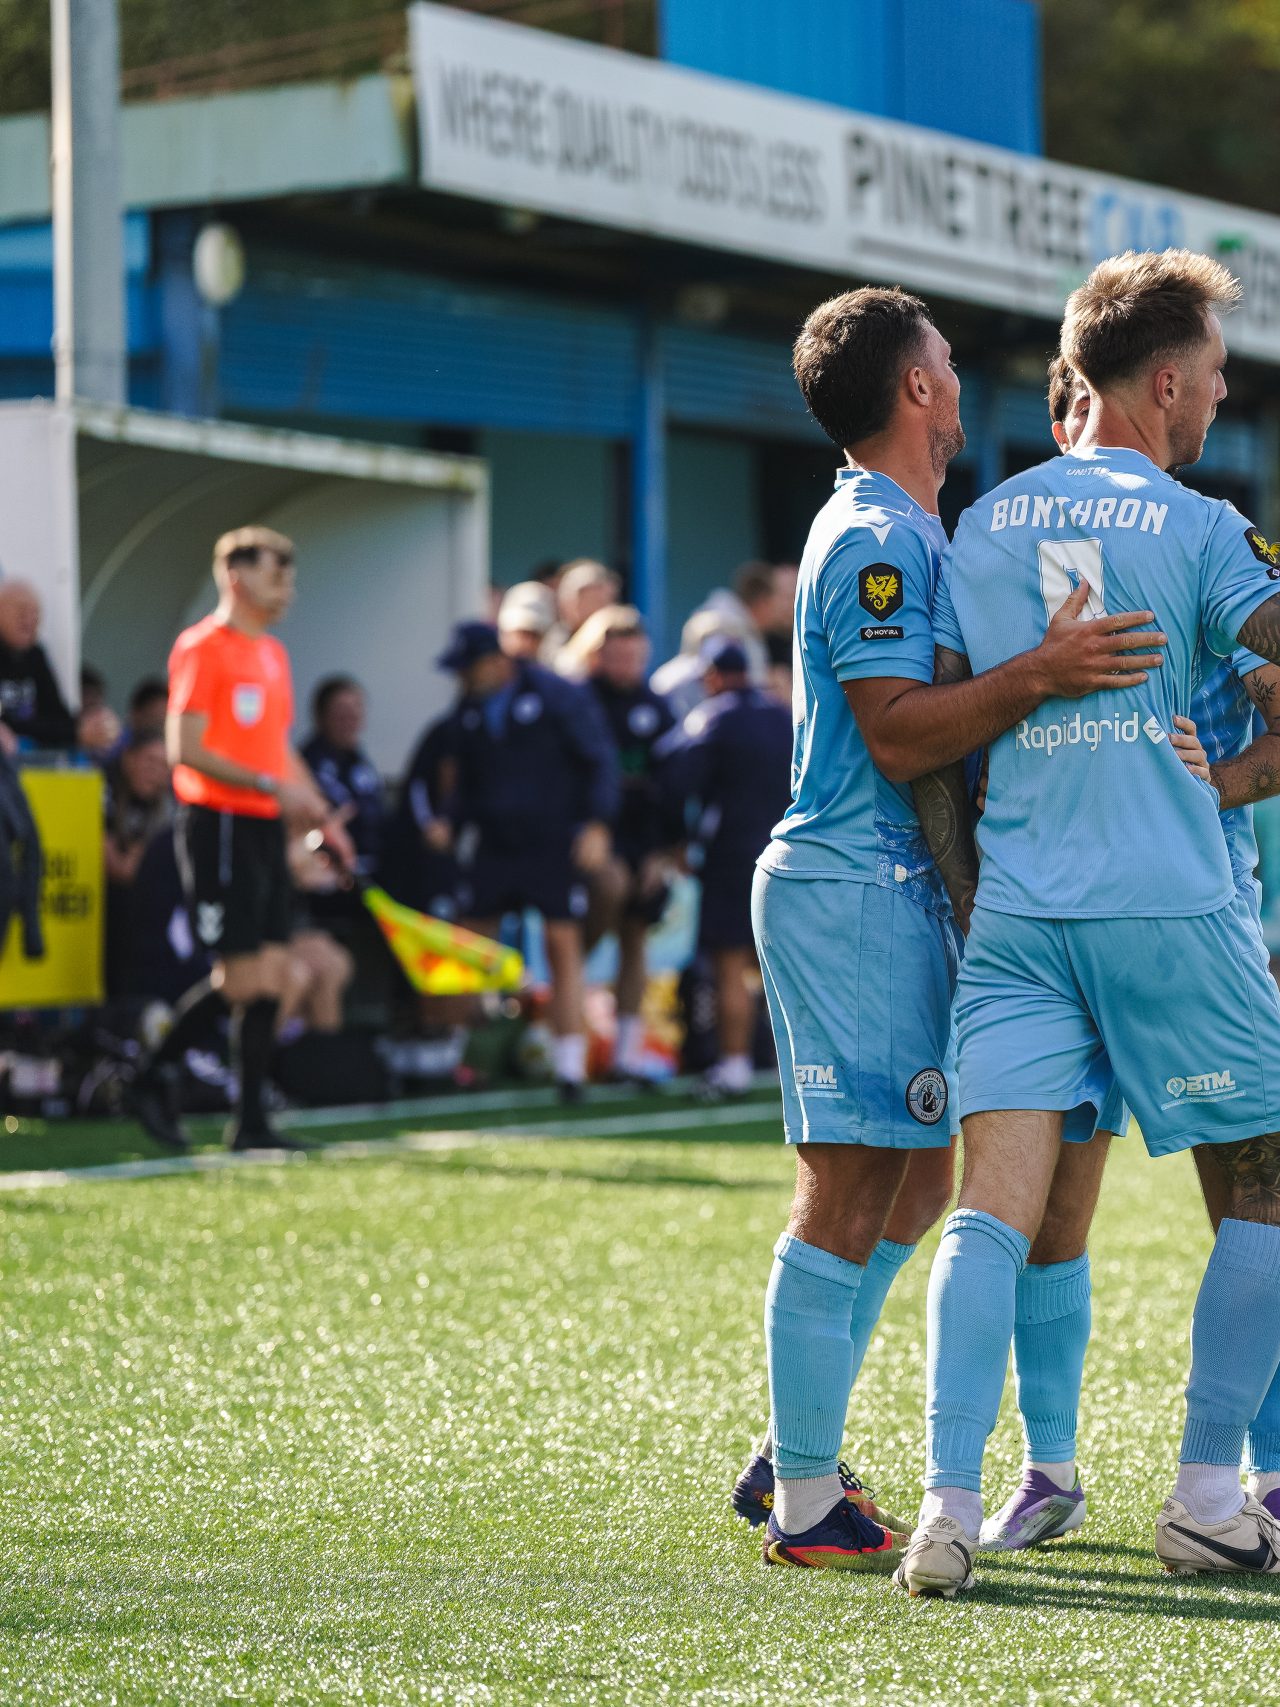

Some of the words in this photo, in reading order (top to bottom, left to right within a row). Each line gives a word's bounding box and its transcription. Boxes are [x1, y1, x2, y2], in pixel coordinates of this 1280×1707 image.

[845, 129, 1087, 264] PINETREE
[990, 494, 1169, 536] BONTHRON
[1015, 711, 1139, 756] Rapidgrid
[795, 1065, 838, 1084] BTM
[1186, 1069, 1236, 1092] BTM
